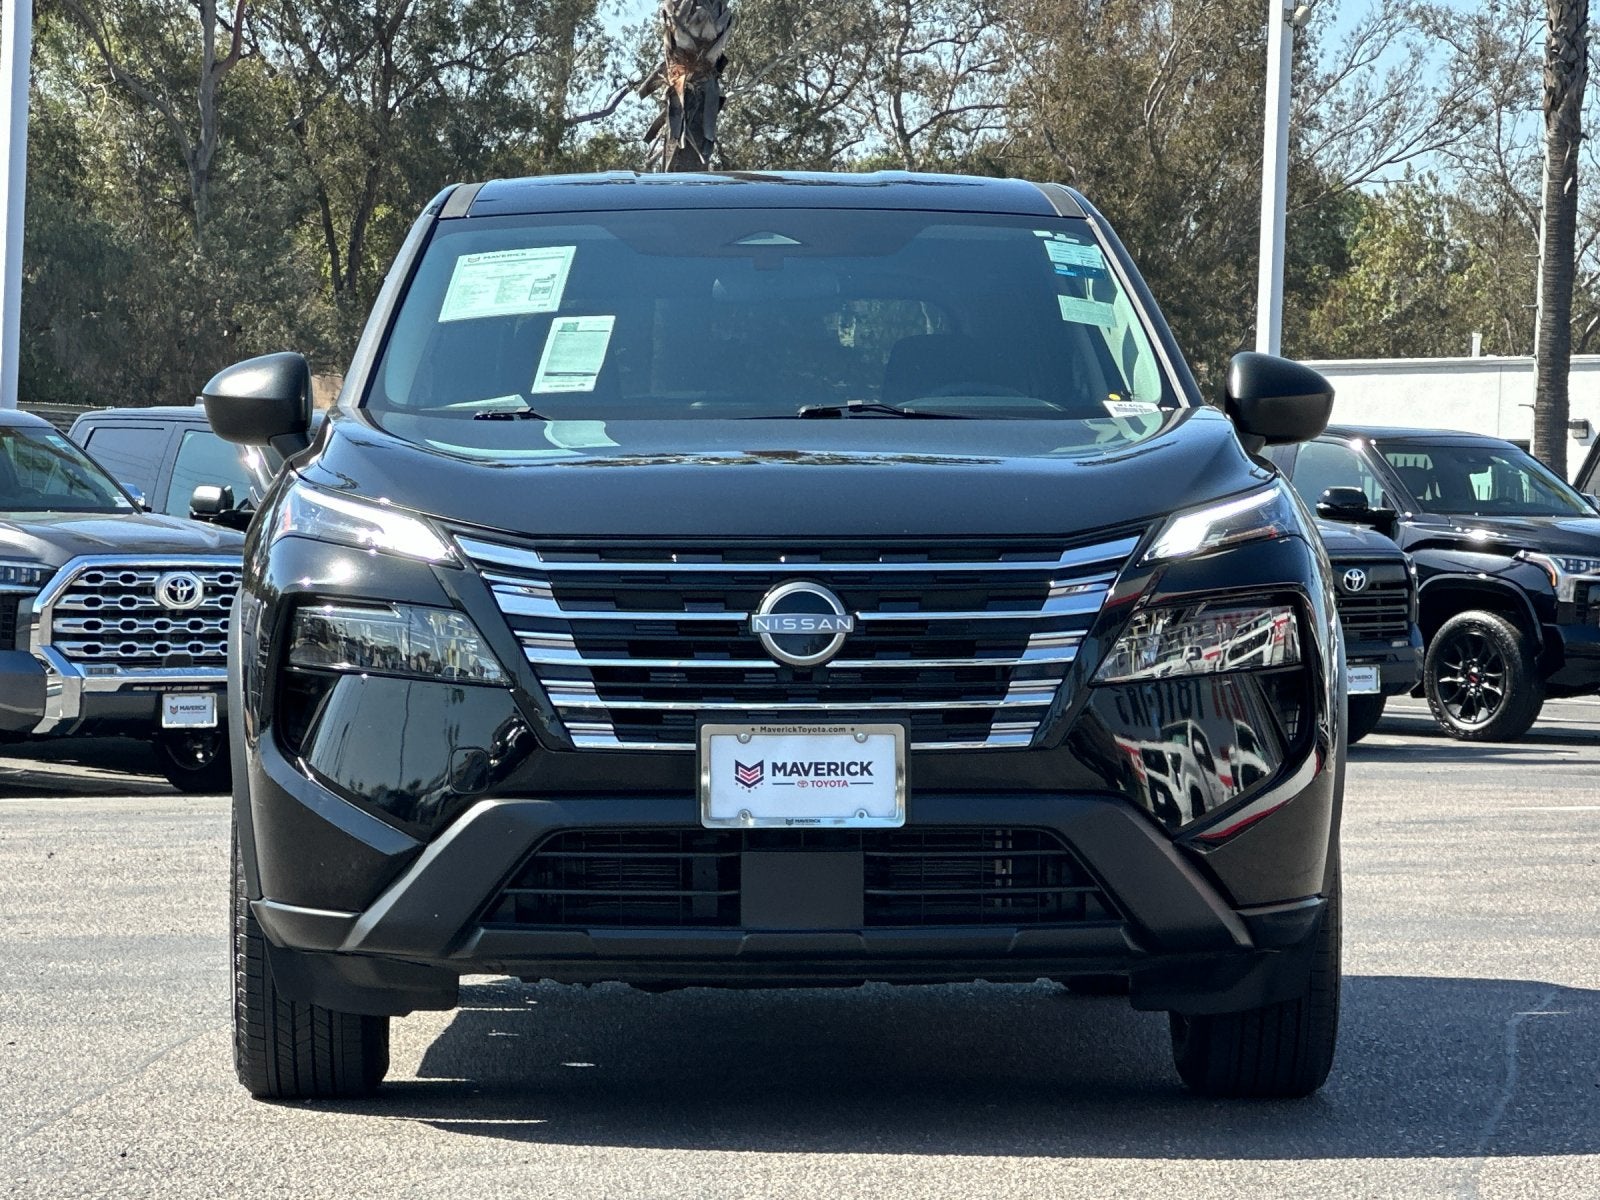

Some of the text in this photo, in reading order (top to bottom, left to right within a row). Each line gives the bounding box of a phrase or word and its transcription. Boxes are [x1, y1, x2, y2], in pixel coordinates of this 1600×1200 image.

[755, 618, 851, 630] NISSAN
[759, 725, 847, 733] MaverickToyota.com
[771, 761, 874, 777] MAVERICK
[810, 780, 849, 788] TOYOTA
